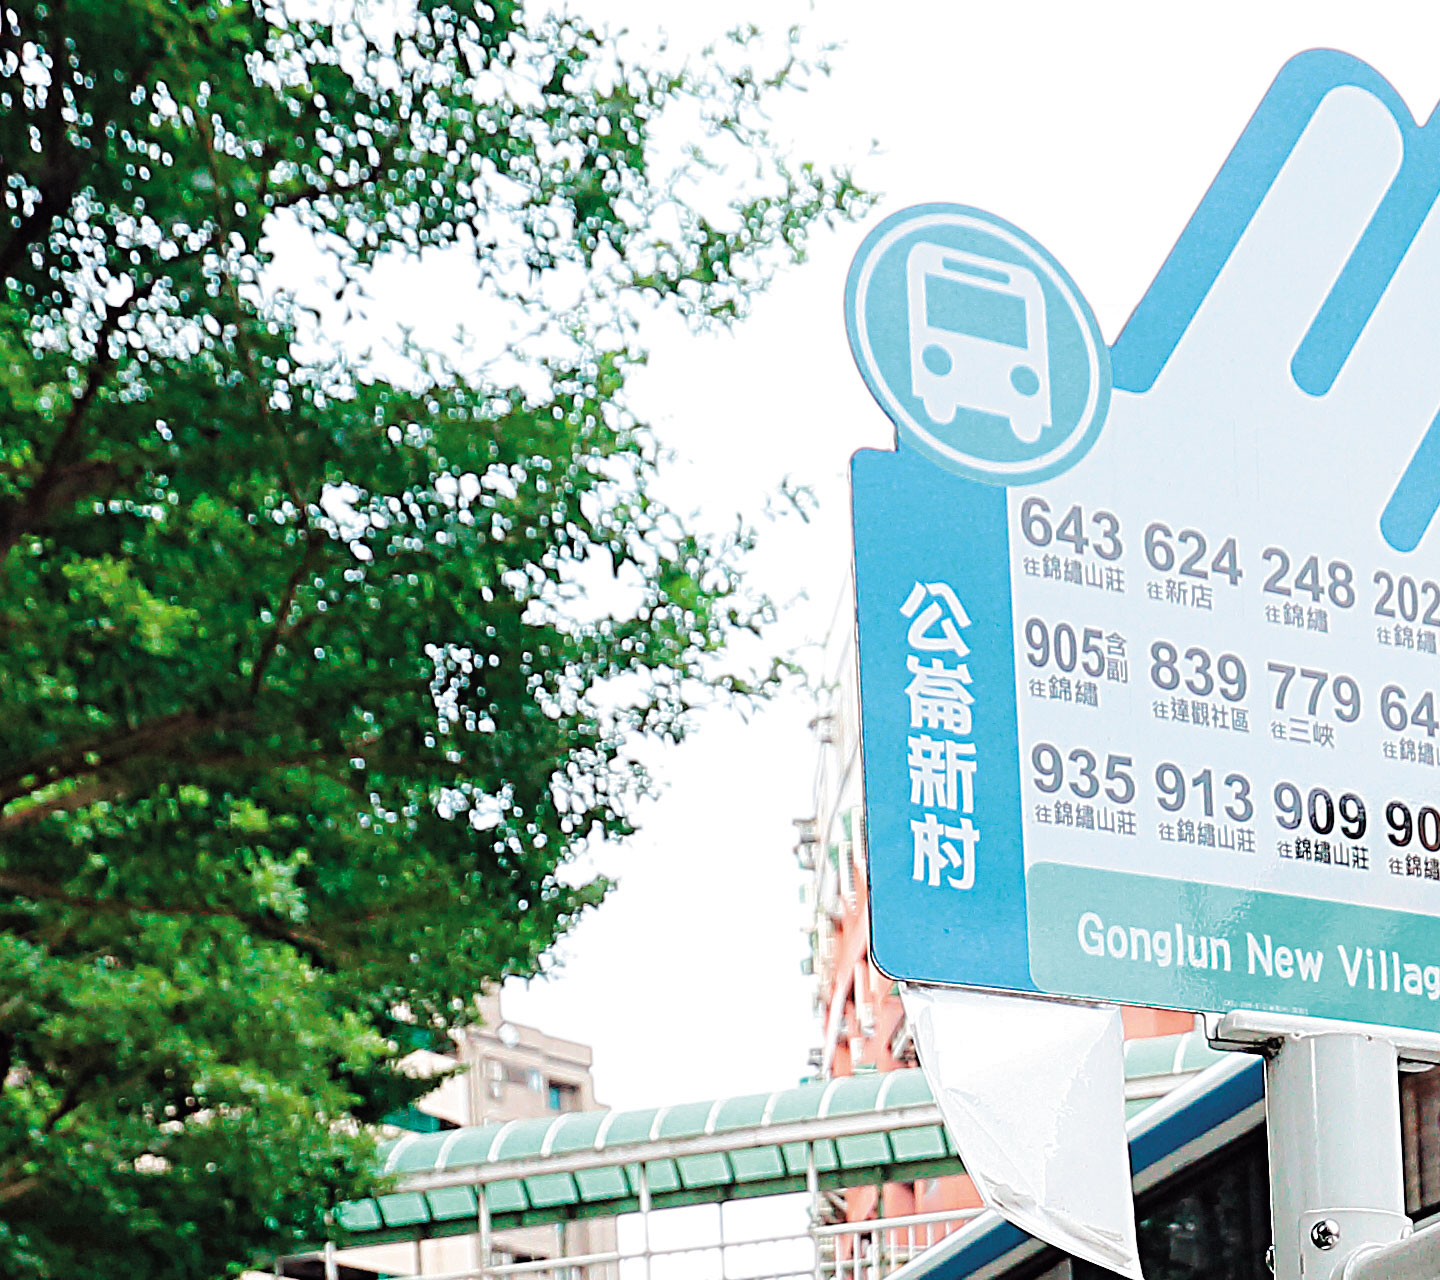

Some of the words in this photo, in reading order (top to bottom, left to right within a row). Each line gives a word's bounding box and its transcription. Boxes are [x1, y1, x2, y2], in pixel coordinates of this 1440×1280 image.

[1020, 496, 1123, 561] 643
[1144, 522, 1244, 586] 624
[1024, 553, 1125, 593] 往錦繡山莊
[1146, 578, 1213, 610] 往新店
[1262, 547, 1356, 609] 248
[1265, 602, 1329, 633] 往錦繡
[1376, 624, 1437, 654] 往錦繡
[1024, 617, 1106, 677] 905
[1150, 641, 1247, 701] 839
[1029, 675, 1099, 707] 往錦繡
[1152, 696, 1250, 733] 往達觀社區
[1267, 662, 1361, 723] 779
[898, 579, 981, 892] 公崙新村
[1271, 717, 1335, 749] 往三峽
[1032, 743, 1135, 804] 935
[1155, 762, 1254, 823] 913
[1035, 800, 1137, 836] 往錦繡山莊
[1158, 819, 1256, 853] 往錦繡山莊
[1274, 782, 1367, 840] 909
[1277, 836, 1370, 870] 往錦繡山莊
[1077, 912, 1231, 973] Gonglun
[1247, 933, 1324, 983] New
